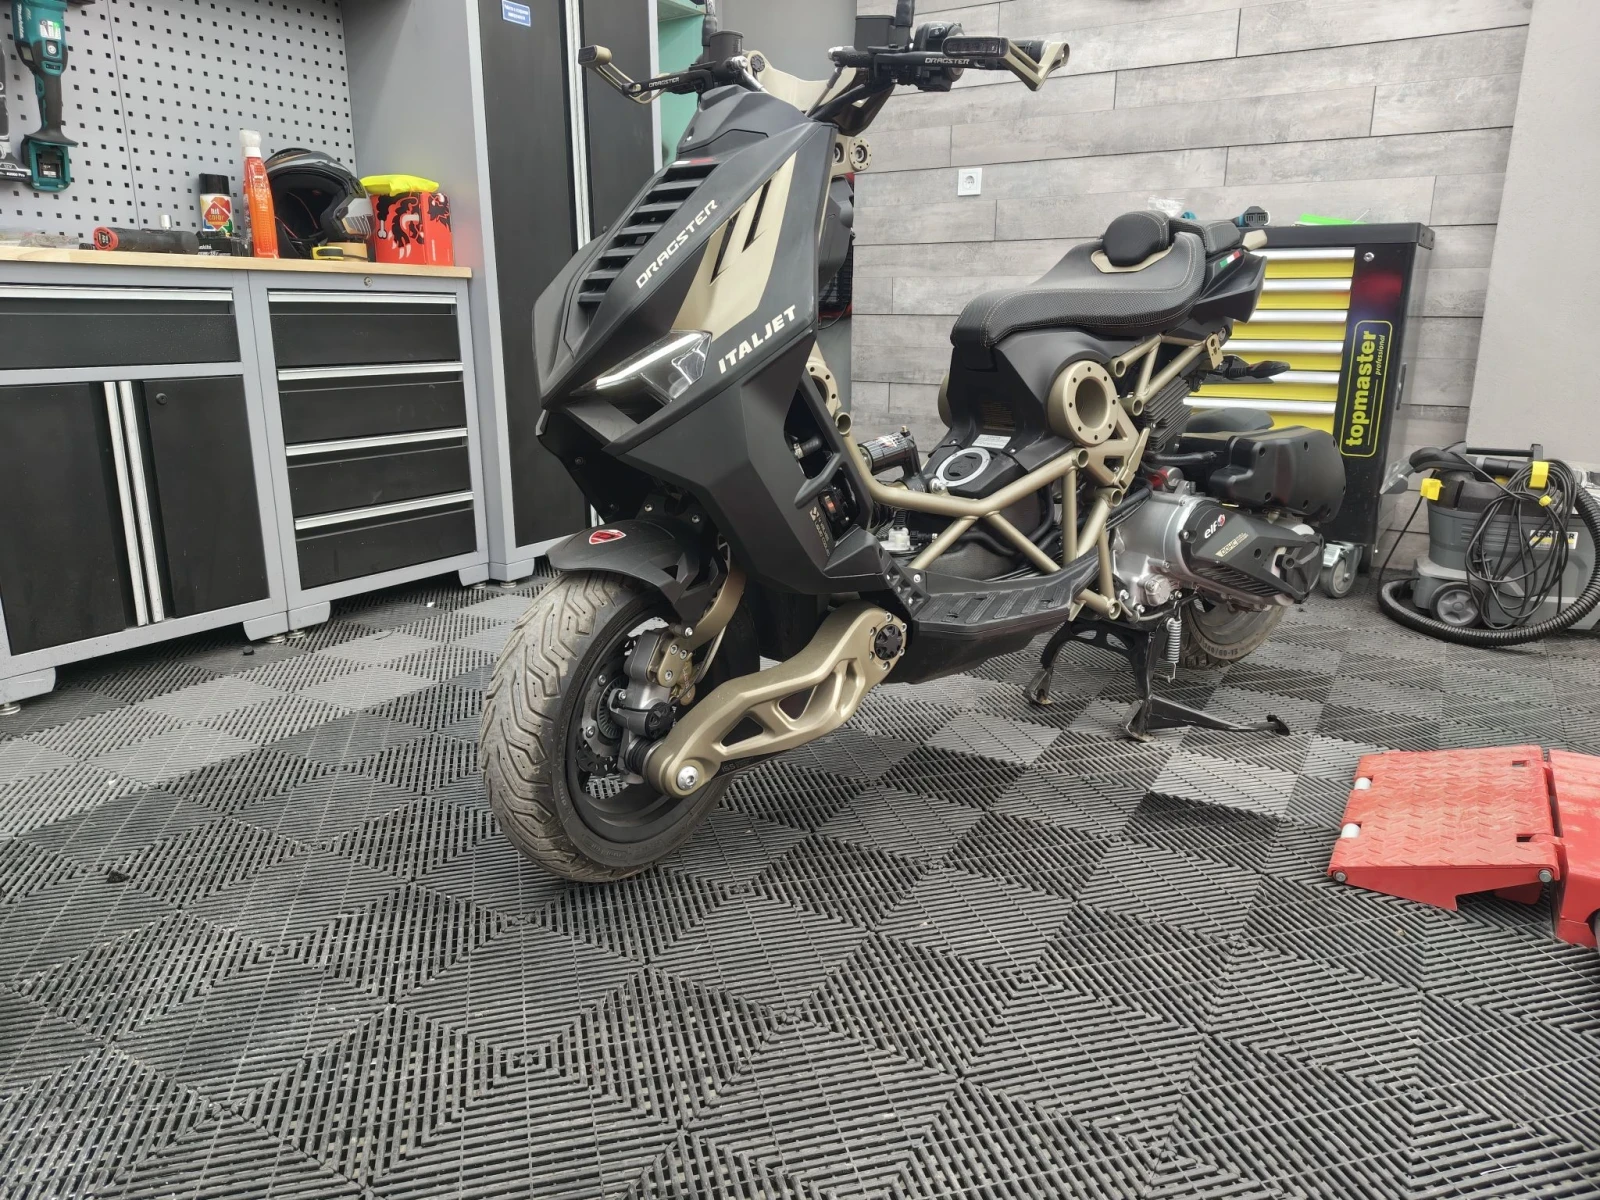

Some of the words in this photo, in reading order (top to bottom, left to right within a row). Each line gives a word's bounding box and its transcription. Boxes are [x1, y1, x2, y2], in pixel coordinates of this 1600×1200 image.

[648, 76, 680, 88] DRAGSTER
[925, 57, 970, 65] DRAGSTER
[635, 199, 719, 289] DRAGSTER
[718, 304, 796, 374] ITALJET
[1375, 334, 1386, 376] professional
[1345, 330, 1377, 447] topmaster
[1204, 520, 1218, 539] elf
